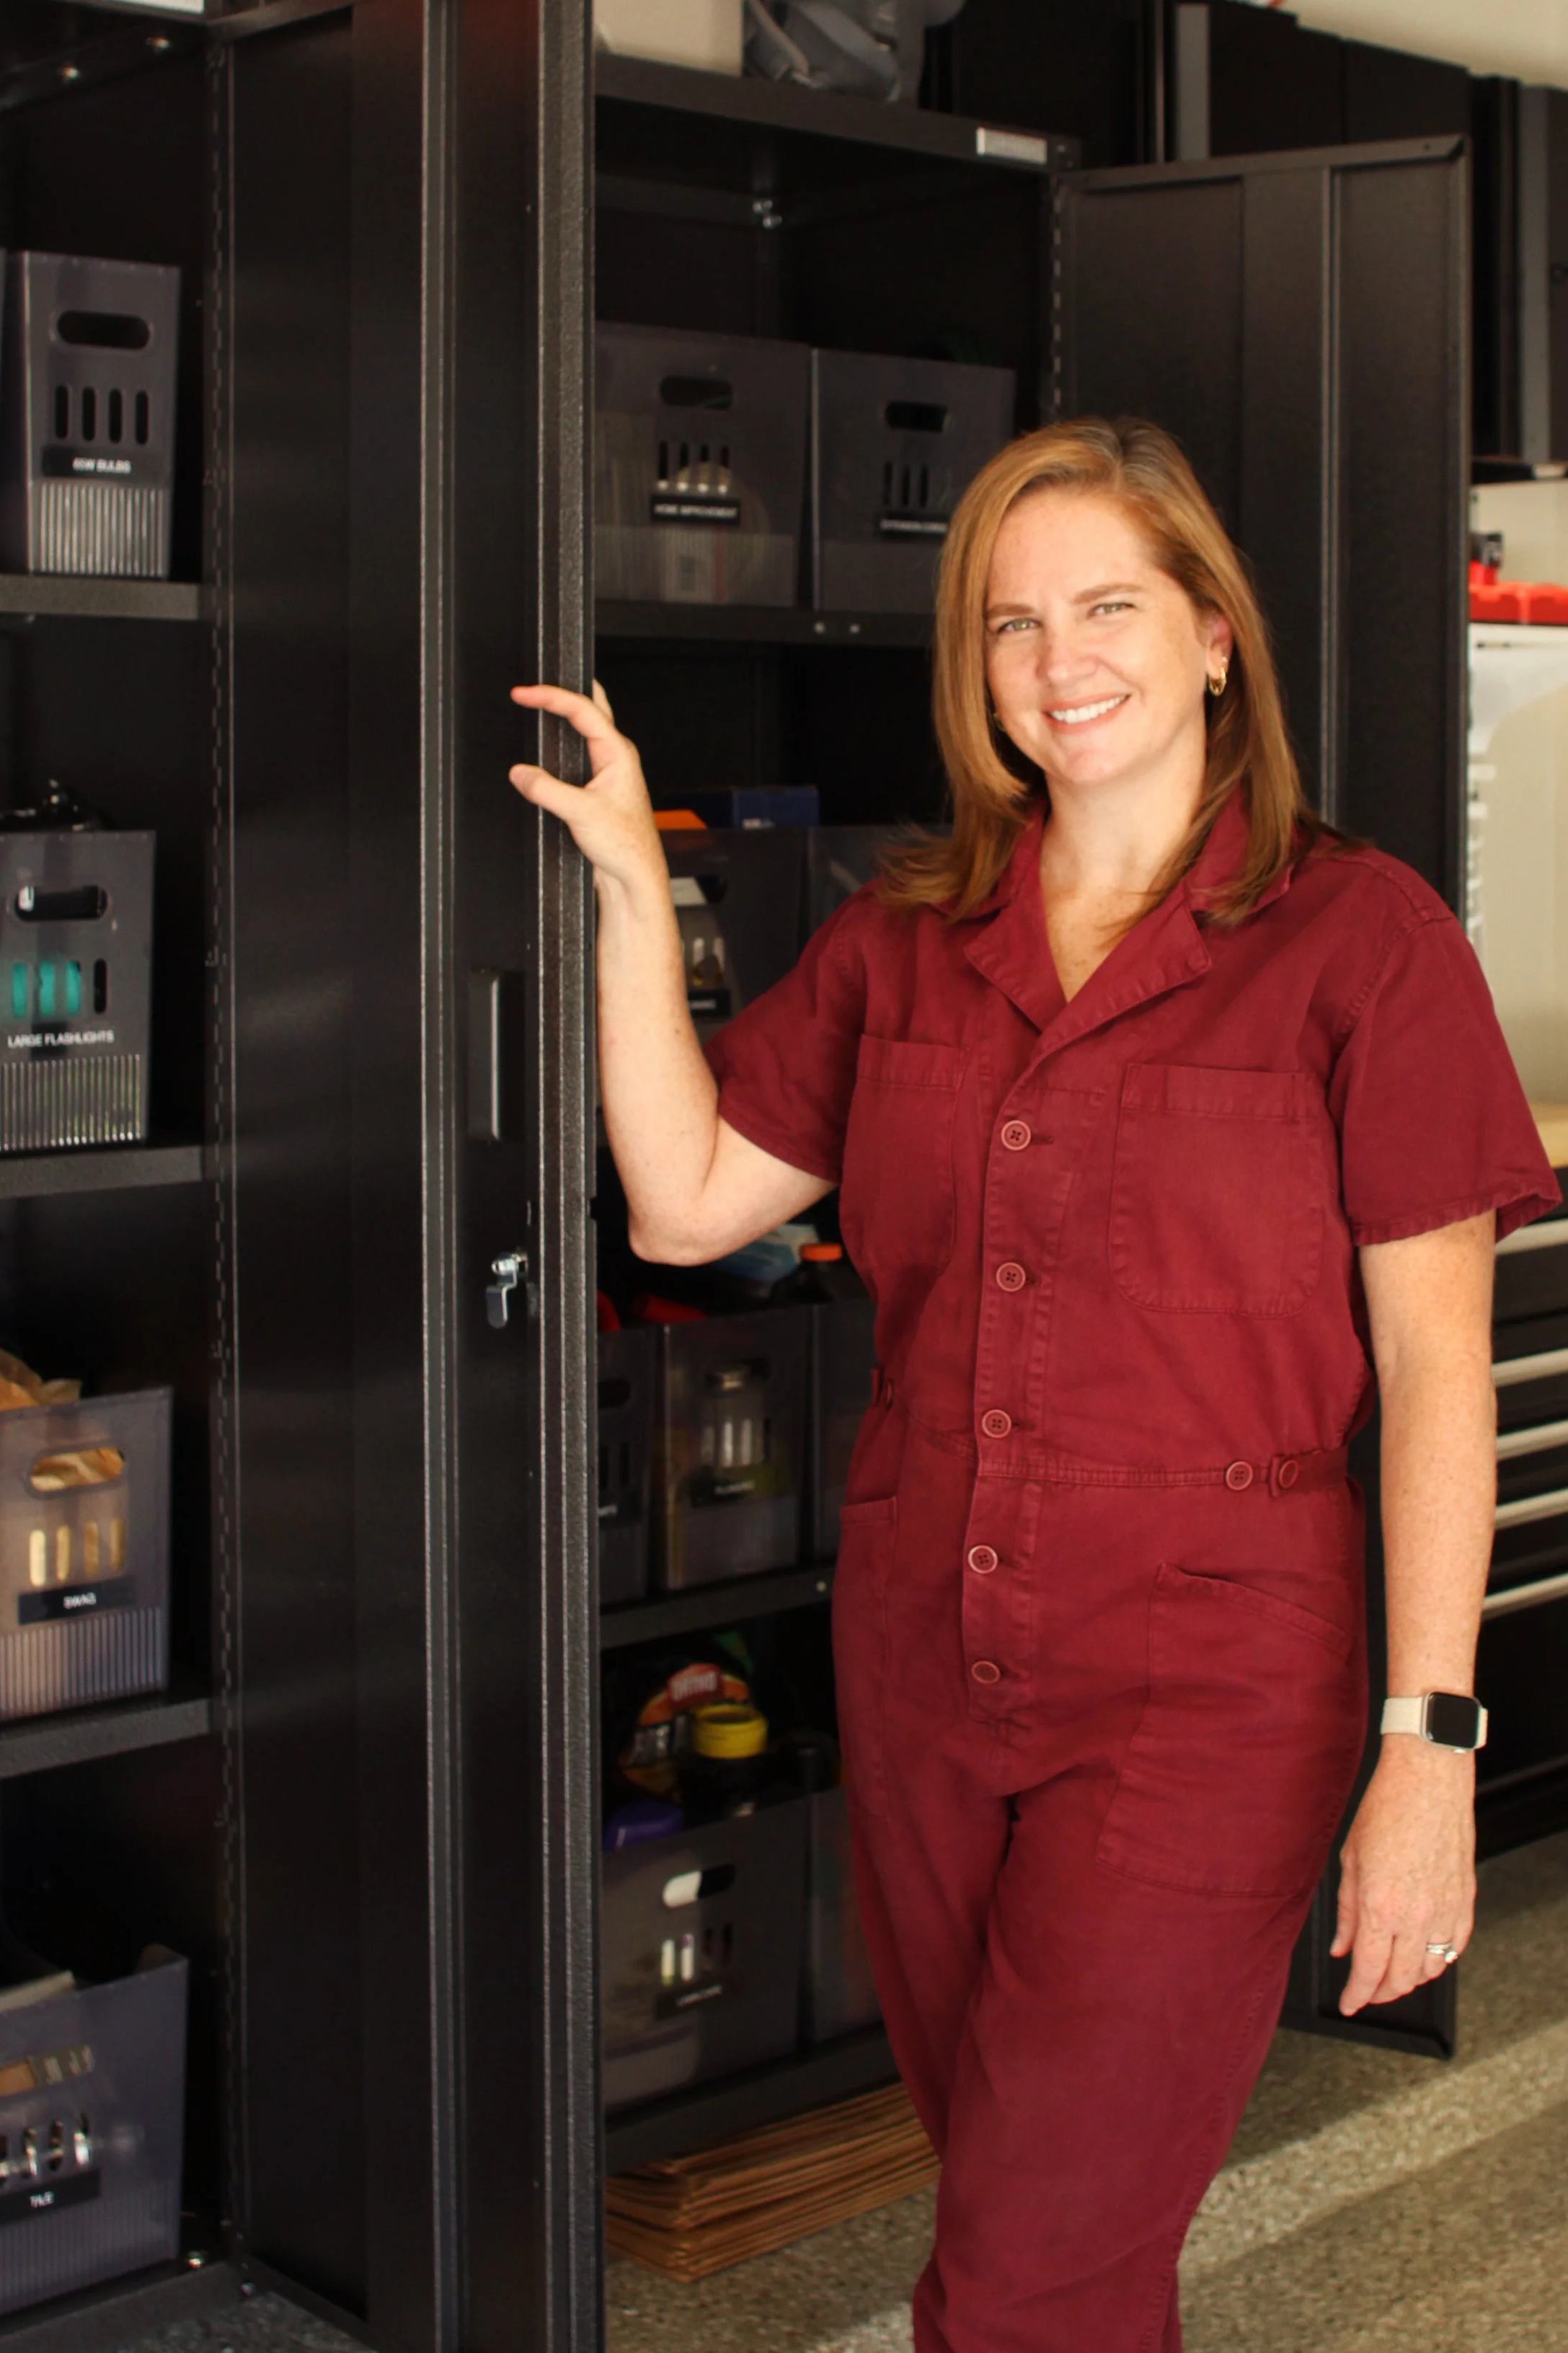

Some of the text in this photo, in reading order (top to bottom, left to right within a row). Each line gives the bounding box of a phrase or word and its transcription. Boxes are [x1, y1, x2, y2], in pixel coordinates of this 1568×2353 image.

[96, 459, 131, 474] BULBS
[7, 1029, 115, 1049] LARGE FLASHLIGHTS
[63, 1592, 97, 1610] SWAG
